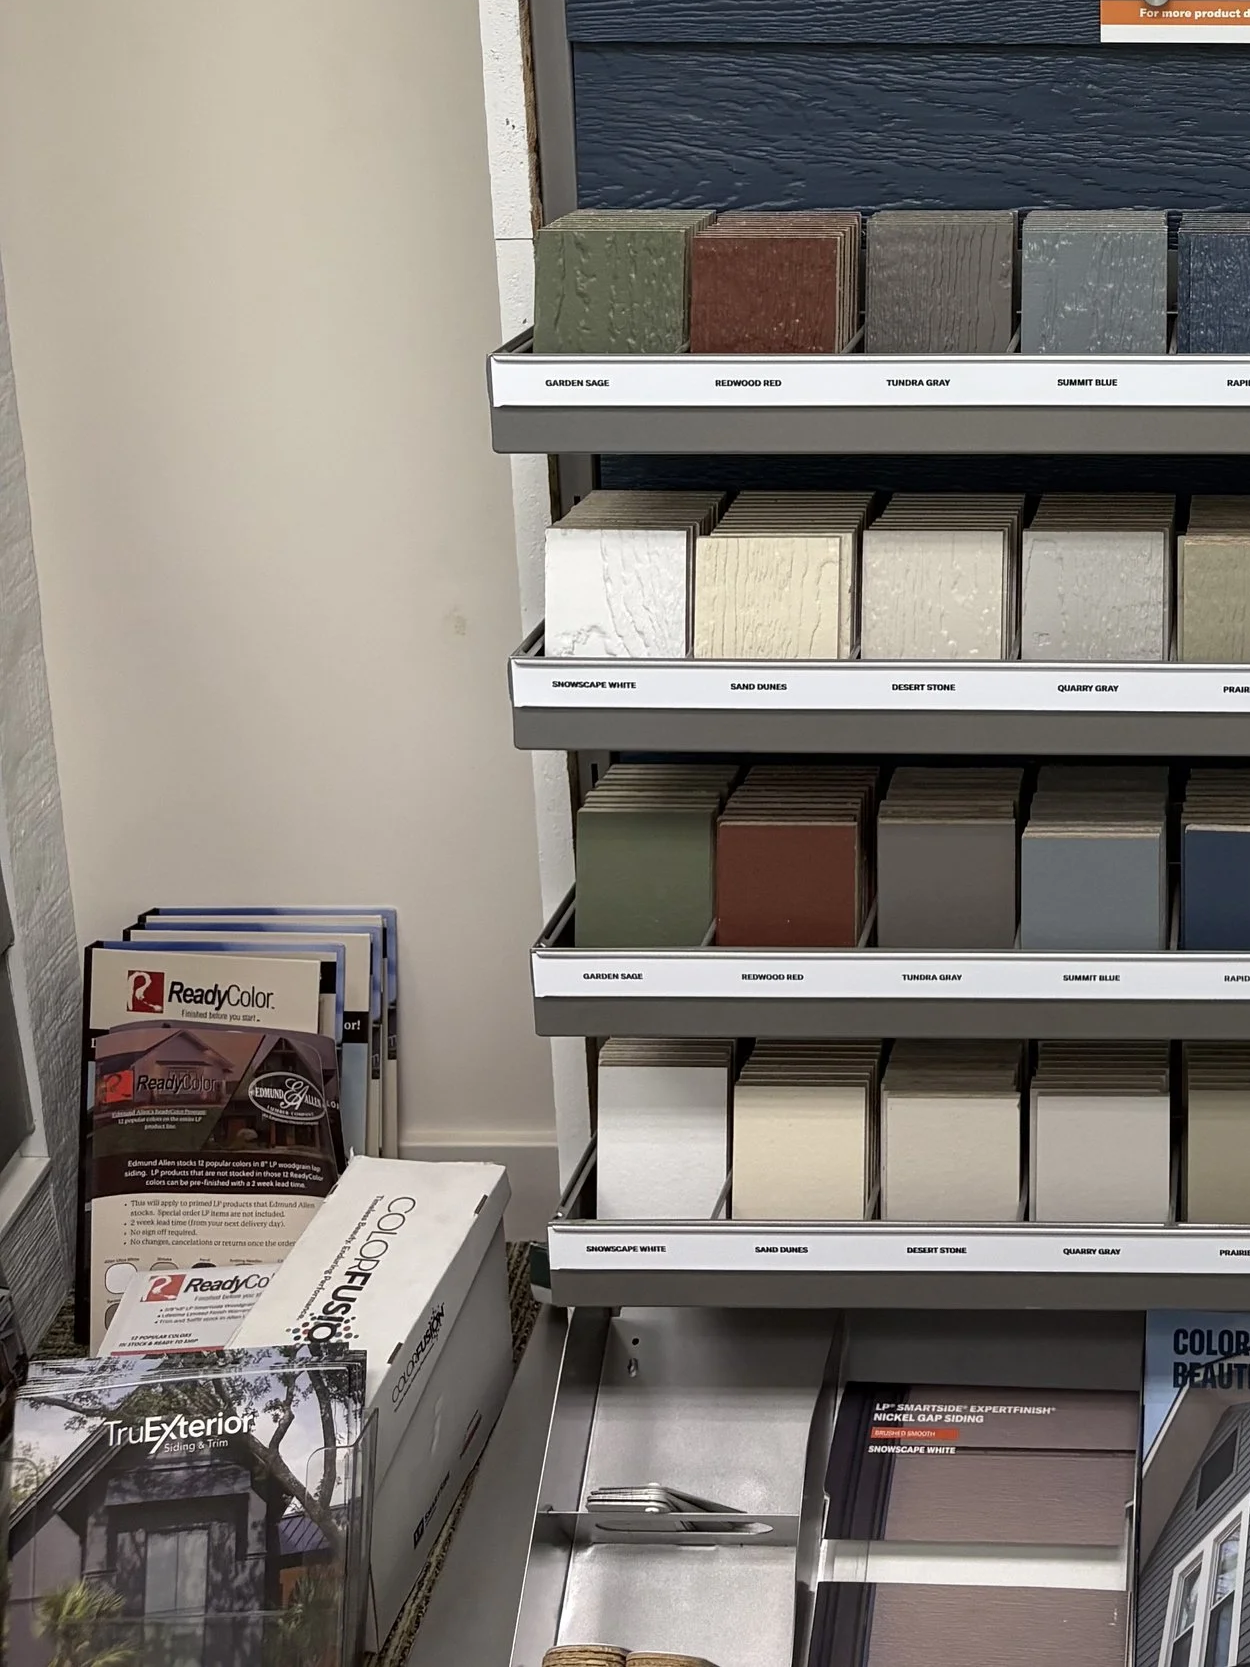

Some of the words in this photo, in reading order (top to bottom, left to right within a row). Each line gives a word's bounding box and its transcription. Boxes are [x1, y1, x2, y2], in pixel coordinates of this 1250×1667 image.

[1140, 8, 1159, 18] For
[1162, 10, 1192, 18] more
[1194, 8, 1241, 20] product
[545, 379, 584, 387] GARDEN
[585, 379, 610, 387] SAGE
[715, 379, 762, 387] REDWOOD
[763, 379, 782, 387] RED
[886, 379, 924, 387] TUNDRA
[552, 680, 607, 688] SNOWSCAPE
[1057, 684, 1094, 693] QUARRY
[1094, 684, 1119, 692] GRAY
[255, 1087, 284, 1099] EDMUND
[780, 1246, 809, 1254] DUNES
[307, 1196, 416, 1343] COLORFUSIO
[873, 1413, 915, 1422] NICKEL
[917, 1414, 943, 1422] GAP
[944, 1415, 984, 1424] SIDING
[164, 1441, 196, 1452] Siding
[198, 1441, 205, 1449] &
[207, 1438, 229, 1448] Trim
[868, 1446, 925, 1454] SNOWSCAPE
[927, 1446, 956, 1455] WHITE
